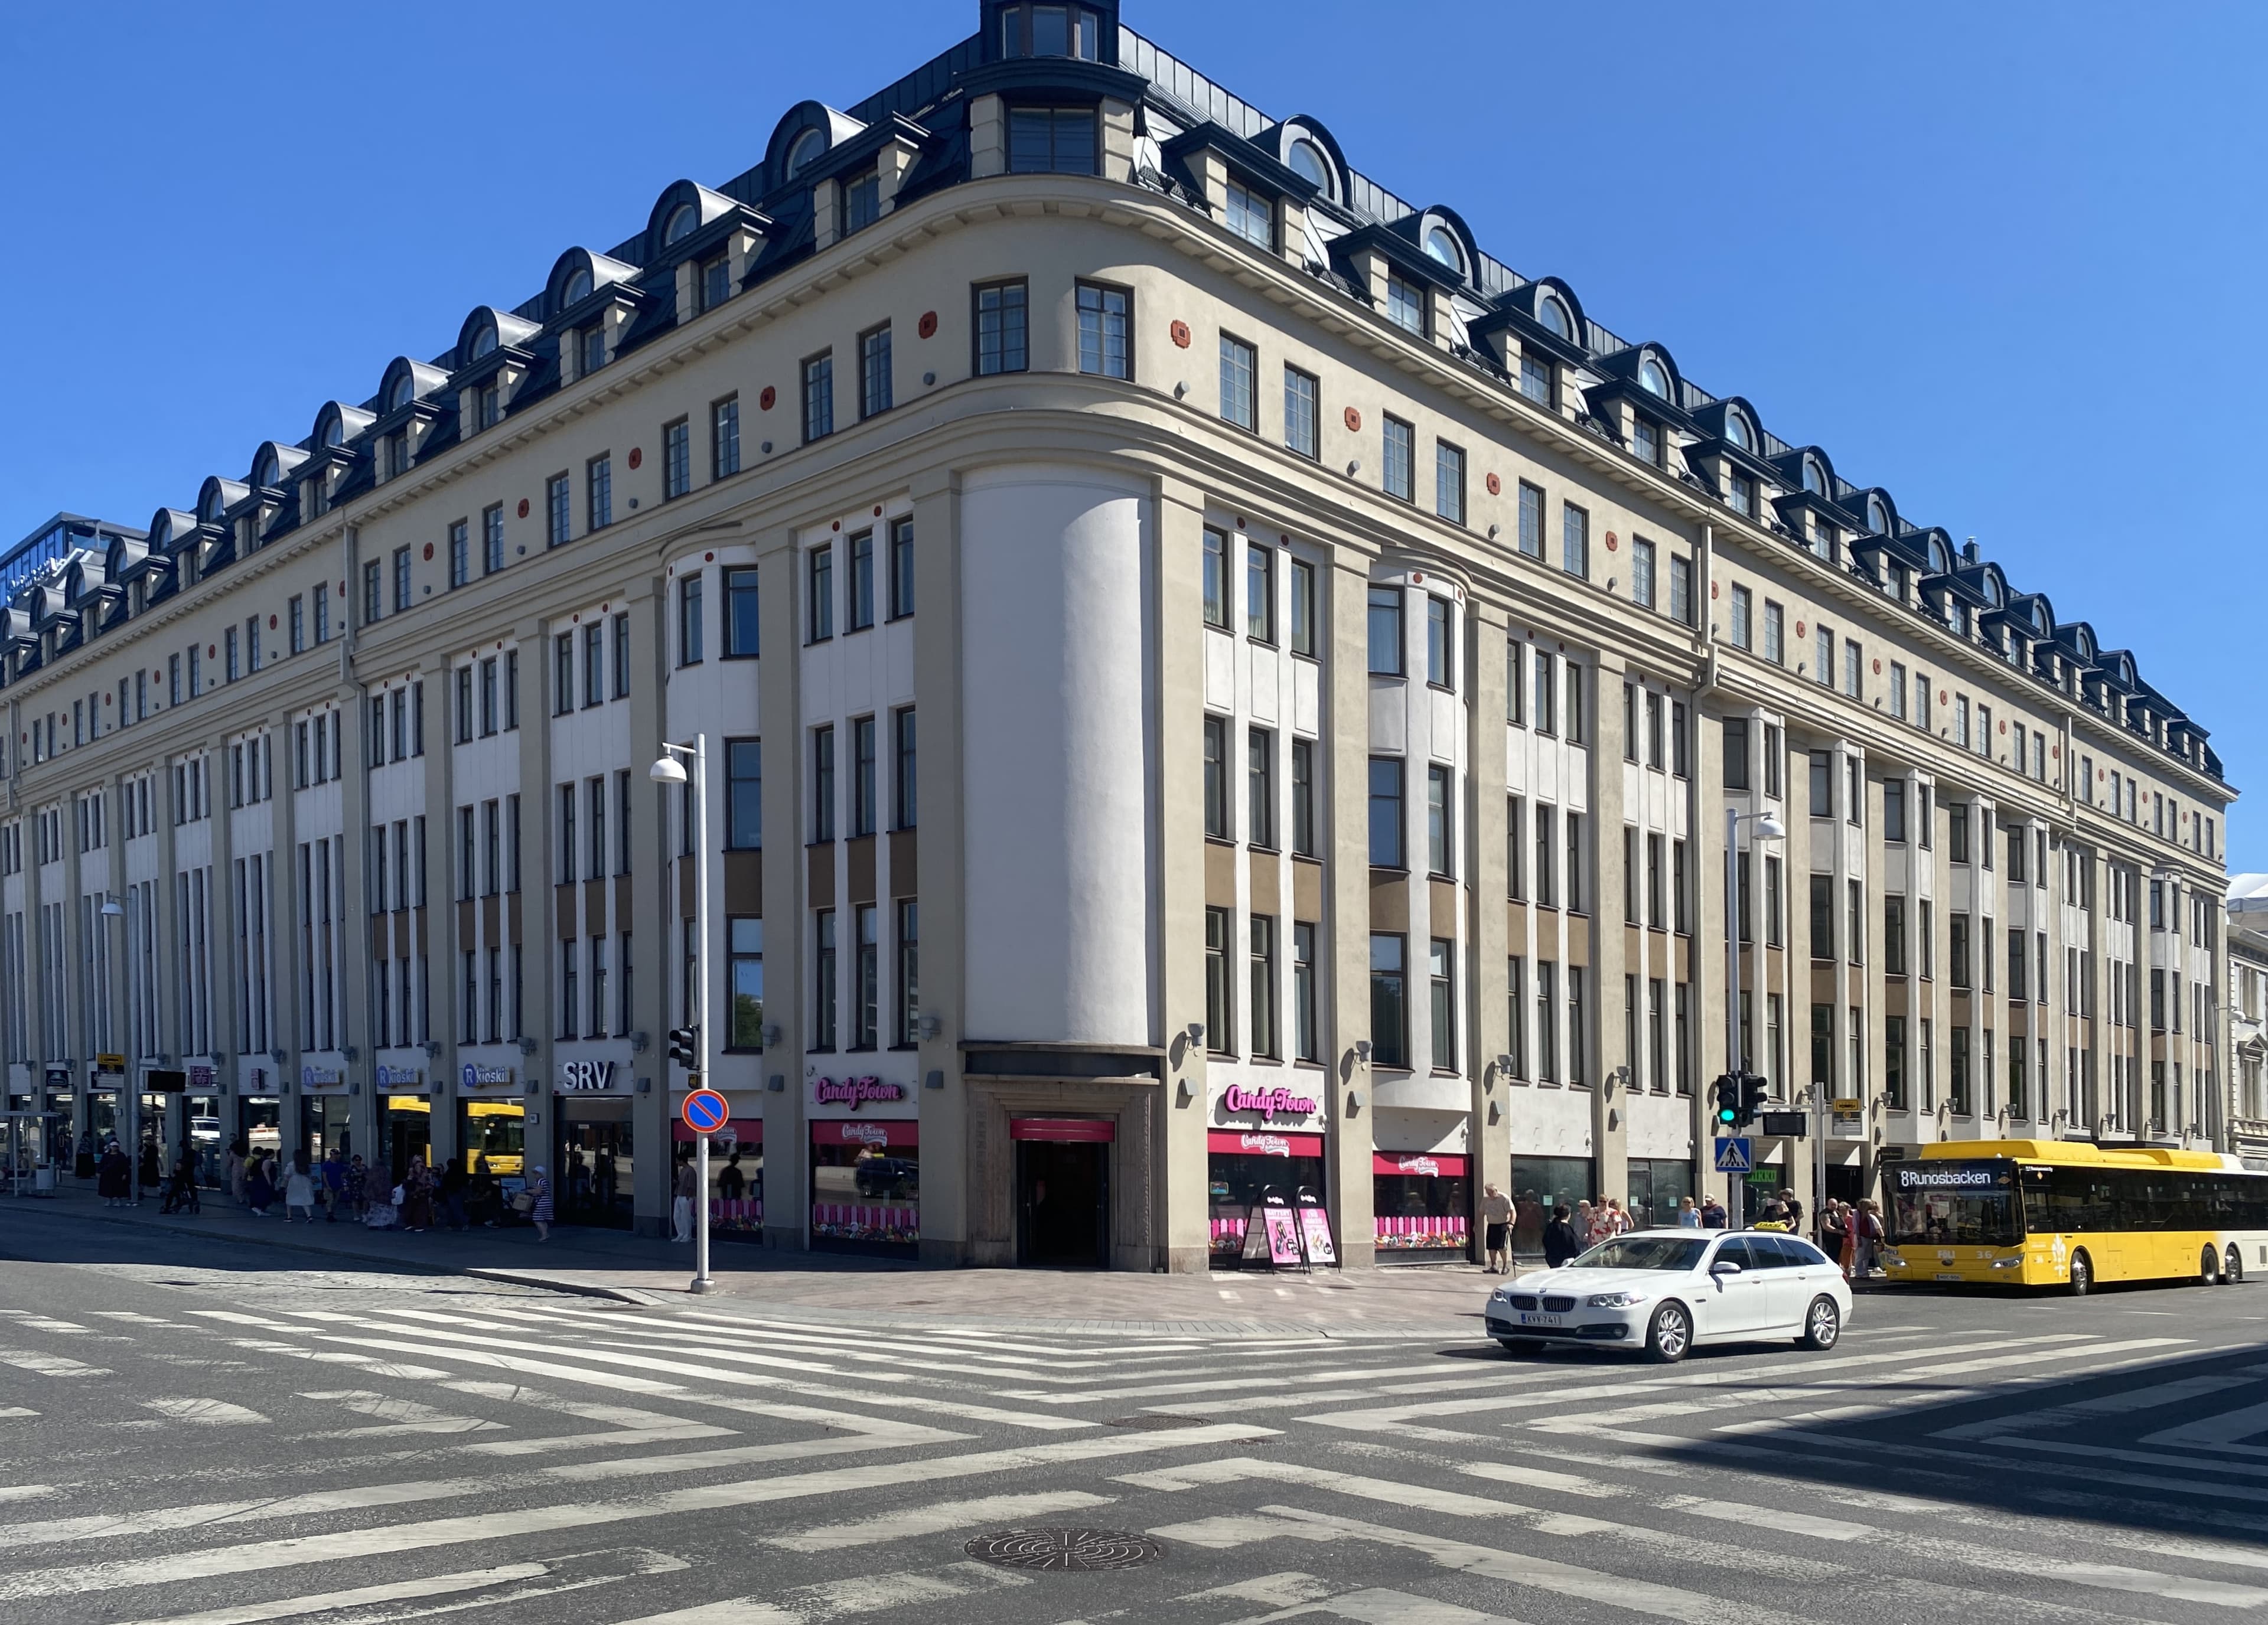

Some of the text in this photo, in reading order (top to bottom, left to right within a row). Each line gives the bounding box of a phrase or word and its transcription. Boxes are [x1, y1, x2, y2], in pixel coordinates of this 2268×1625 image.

[389, 1068, 415, 1083] kioski
[476, 1067, 506, 1084] kioski
[563, 1061, 614, 1089] SRV
[1900, 1170, 1991, 1187] 8 Runosbacken
